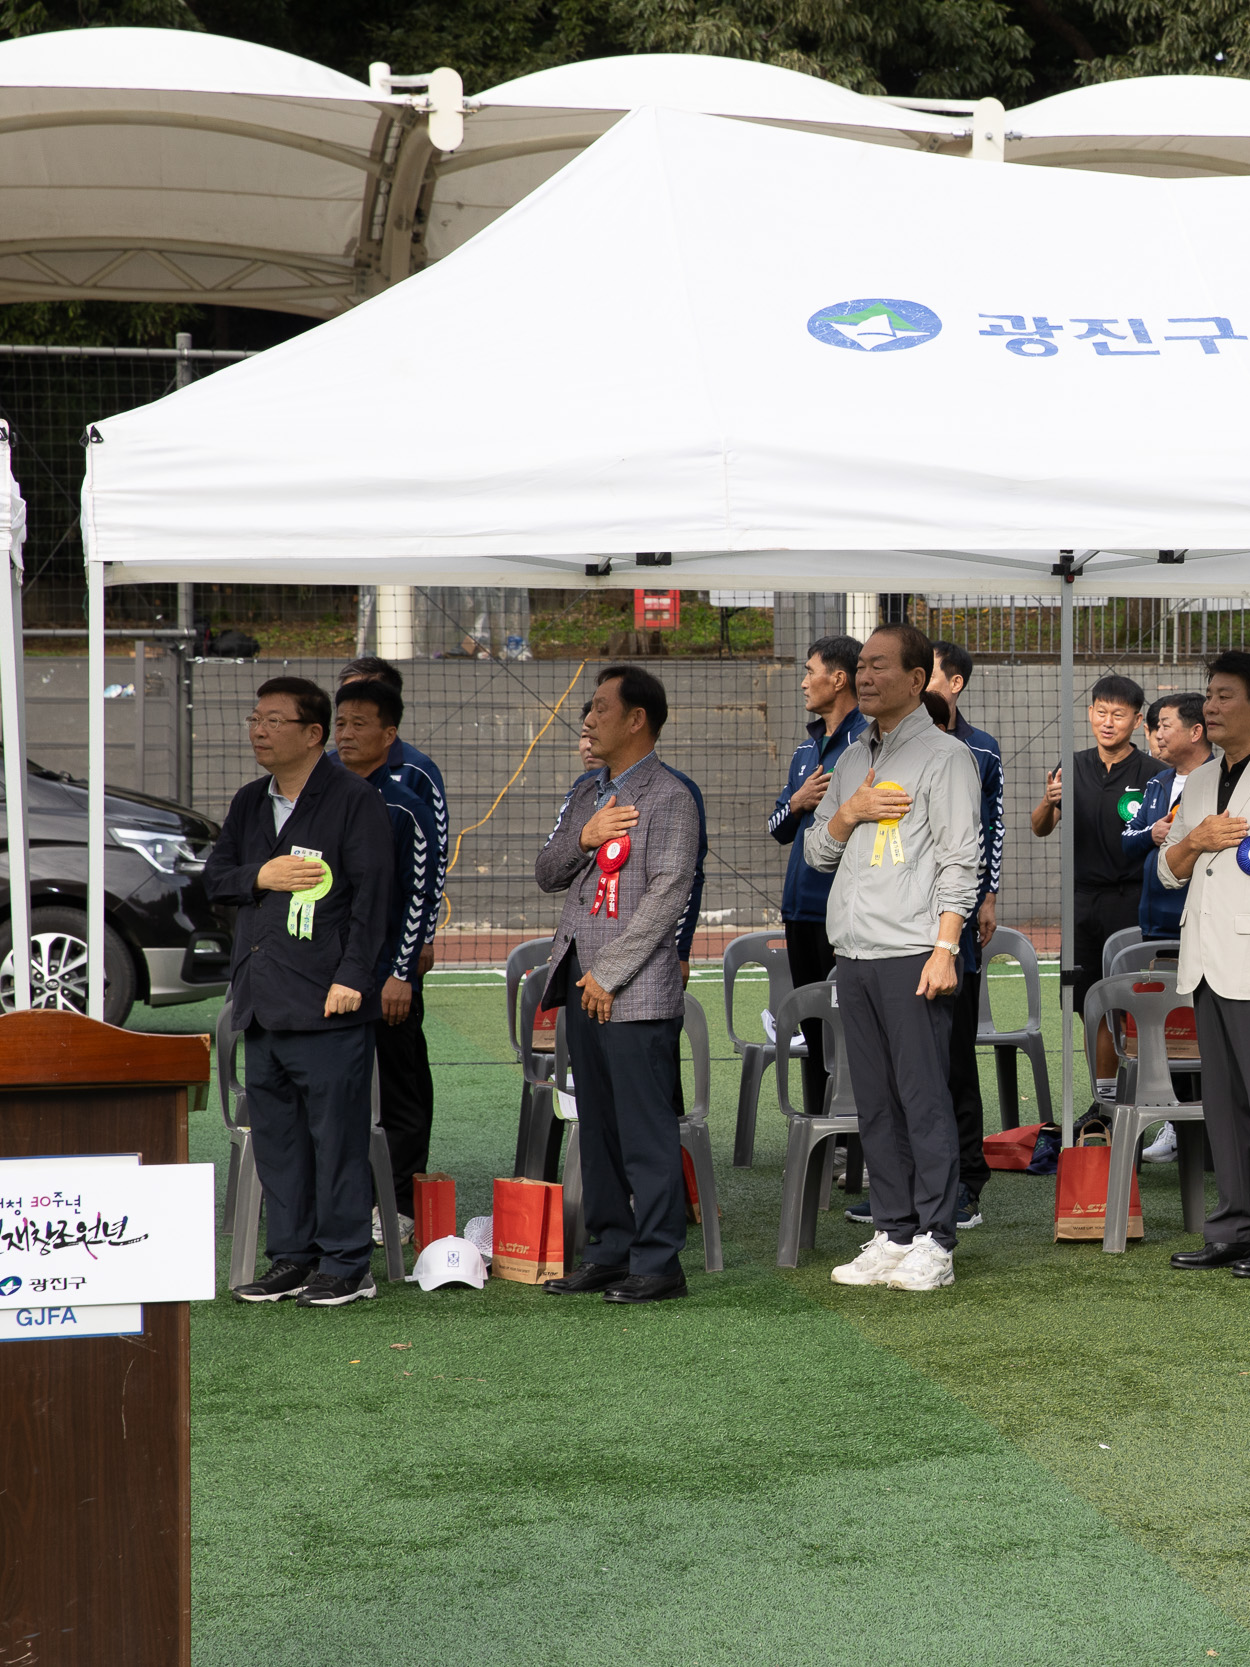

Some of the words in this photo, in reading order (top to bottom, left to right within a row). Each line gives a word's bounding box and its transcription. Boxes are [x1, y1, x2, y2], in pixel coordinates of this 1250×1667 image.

[978, 312, 1249, 357] 광진구
[30, 1191, 82, 1215] 30주년
[29, 1276, 87, 1292] 광진구
[16, 1306, 77, 1327] GJFA
